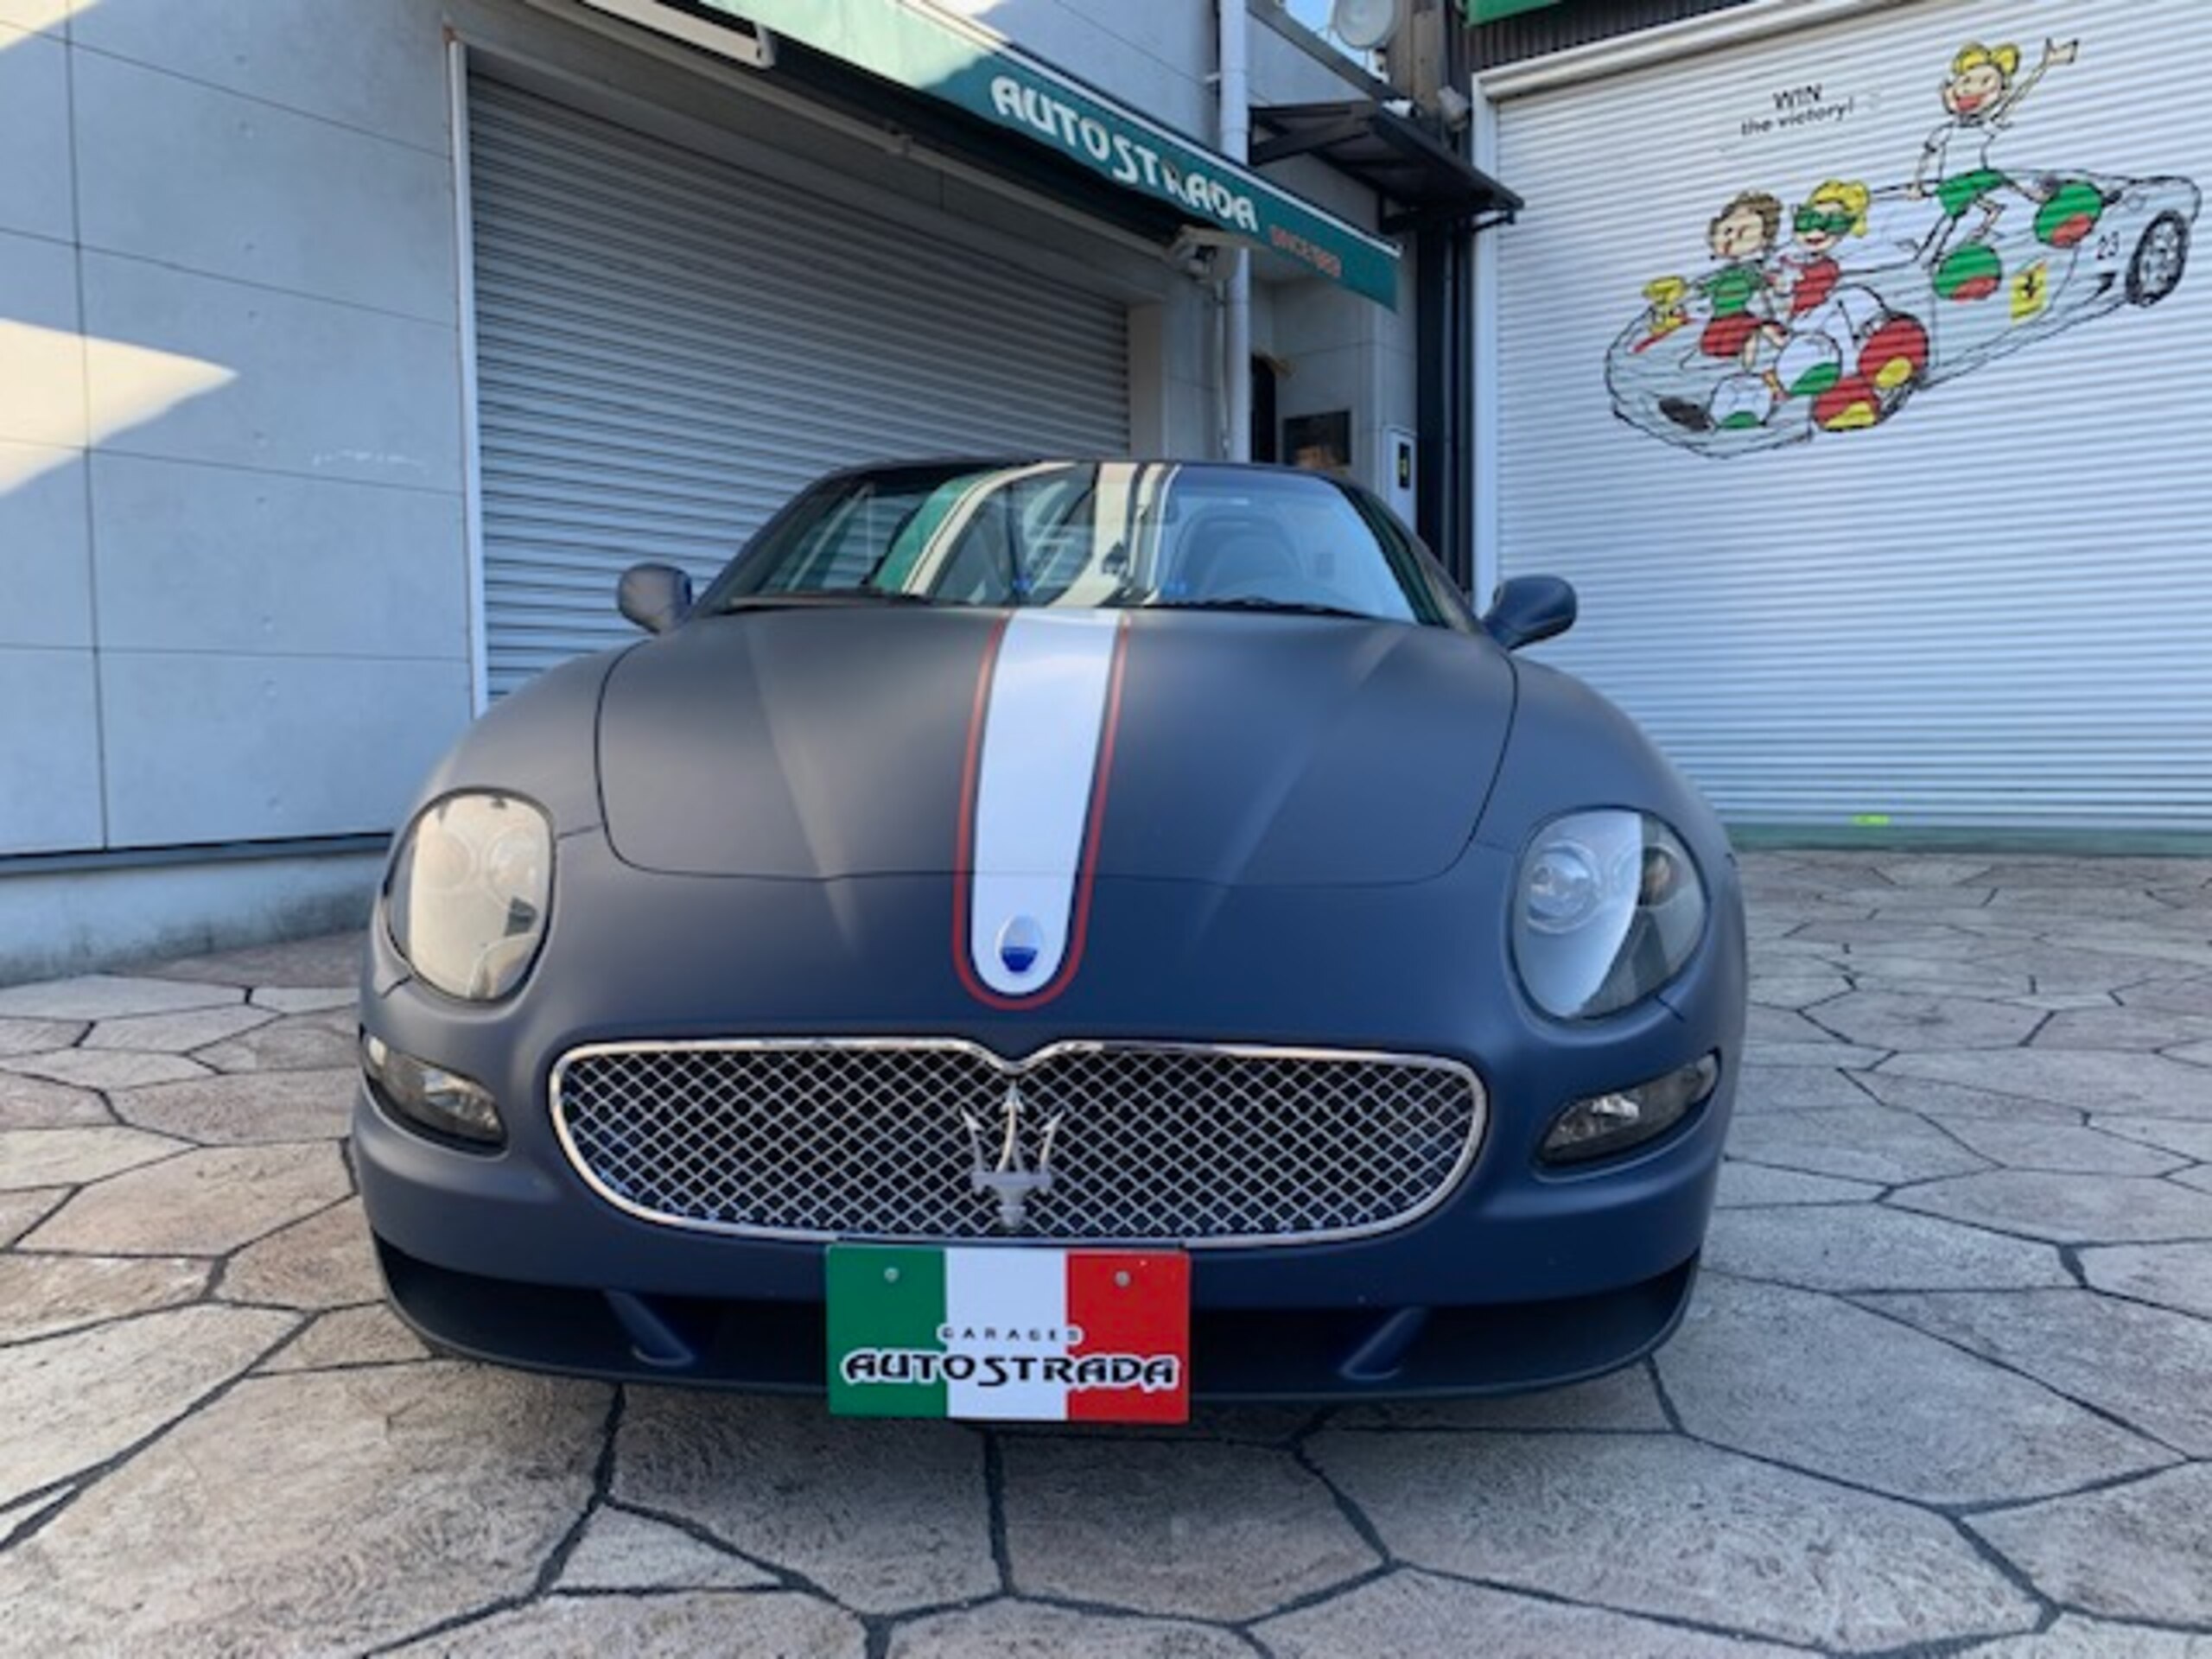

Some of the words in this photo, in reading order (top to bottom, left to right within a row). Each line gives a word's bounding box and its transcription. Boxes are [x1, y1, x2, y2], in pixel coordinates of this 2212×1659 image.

[1772, 83, 1822, 110] WIN
[1740, 118, 1773, 136] the
[990, 75, 1258, 232] AUTOSTRADA
[941, 1326, 1082, 1341] GARAGES
[844, 1351, 1175, 1388] AUTOSTRADA
